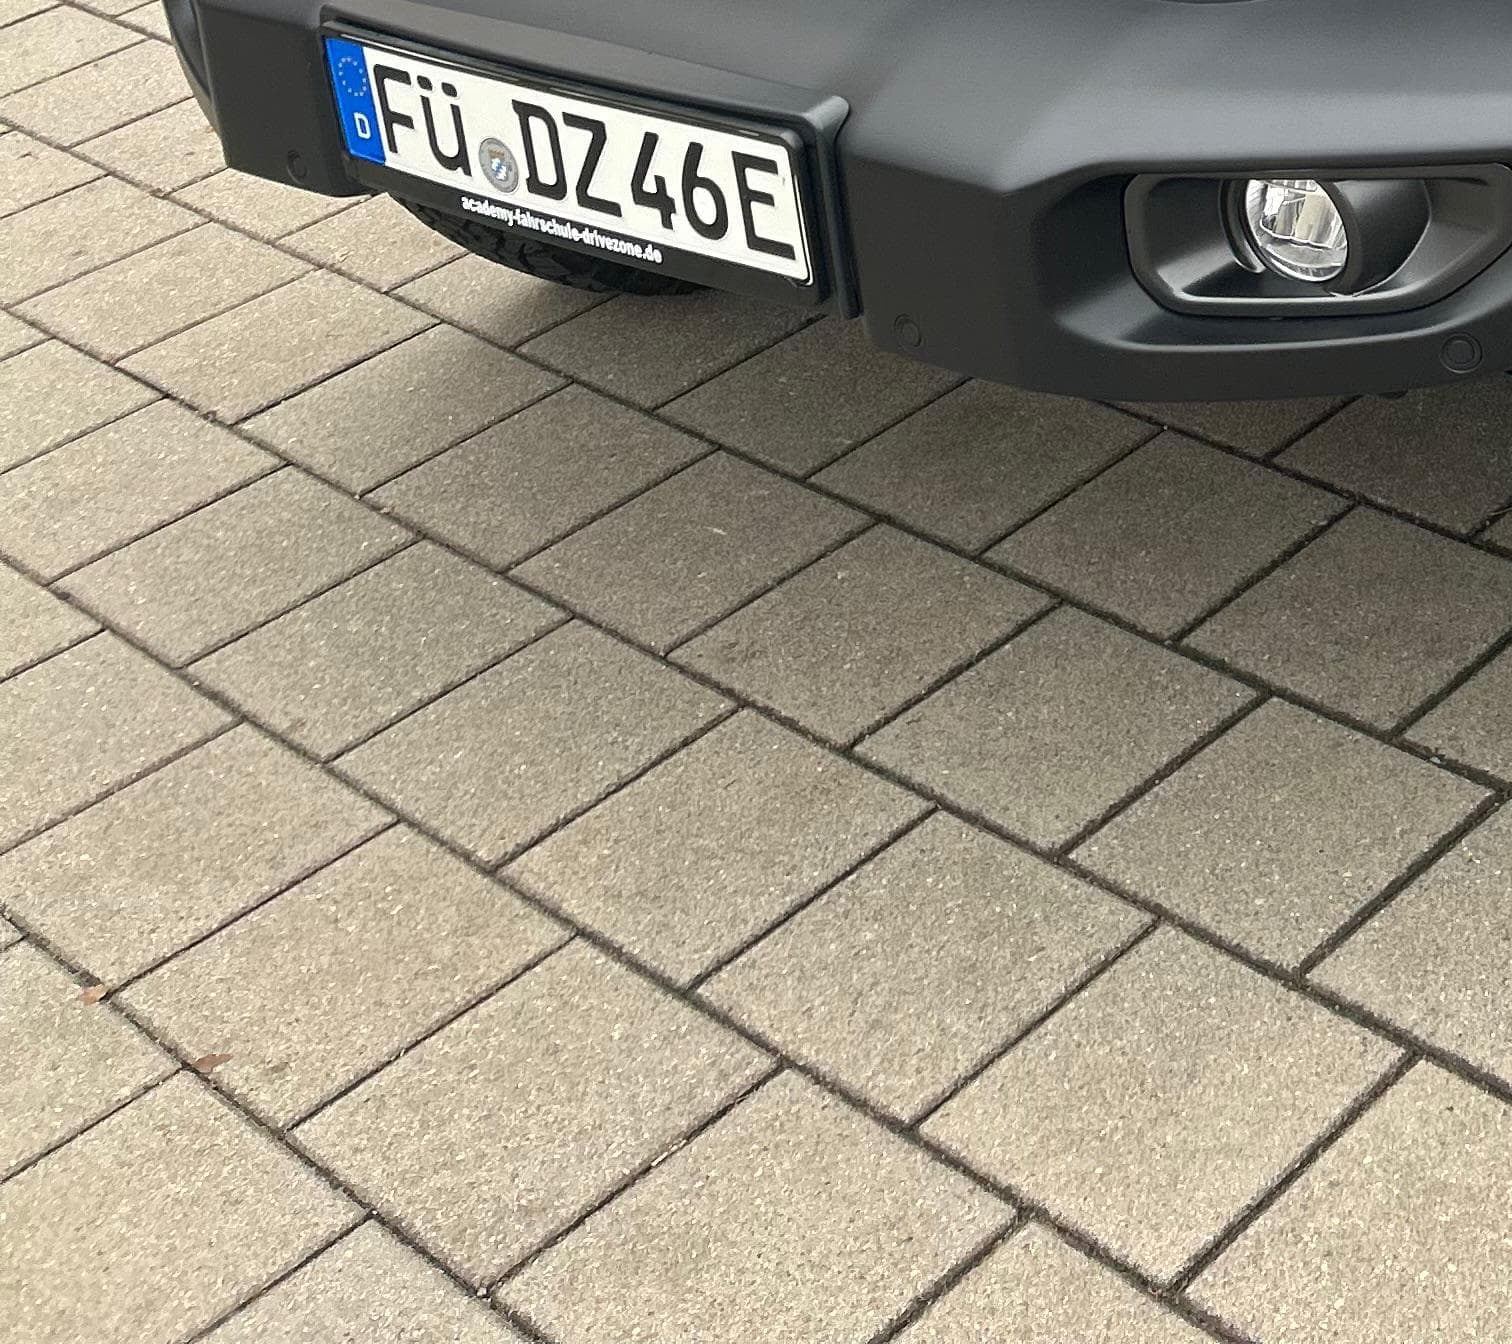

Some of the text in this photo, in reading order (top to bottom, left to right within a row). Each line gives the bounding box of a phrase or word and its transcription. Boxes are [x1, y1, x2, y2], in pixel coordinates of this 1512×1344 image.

[353, 111, 371, 140] D
[373, 63, 473, 177] FÜ
[461, 195, 663, 264] academy-fahrschule-drivezone.de
